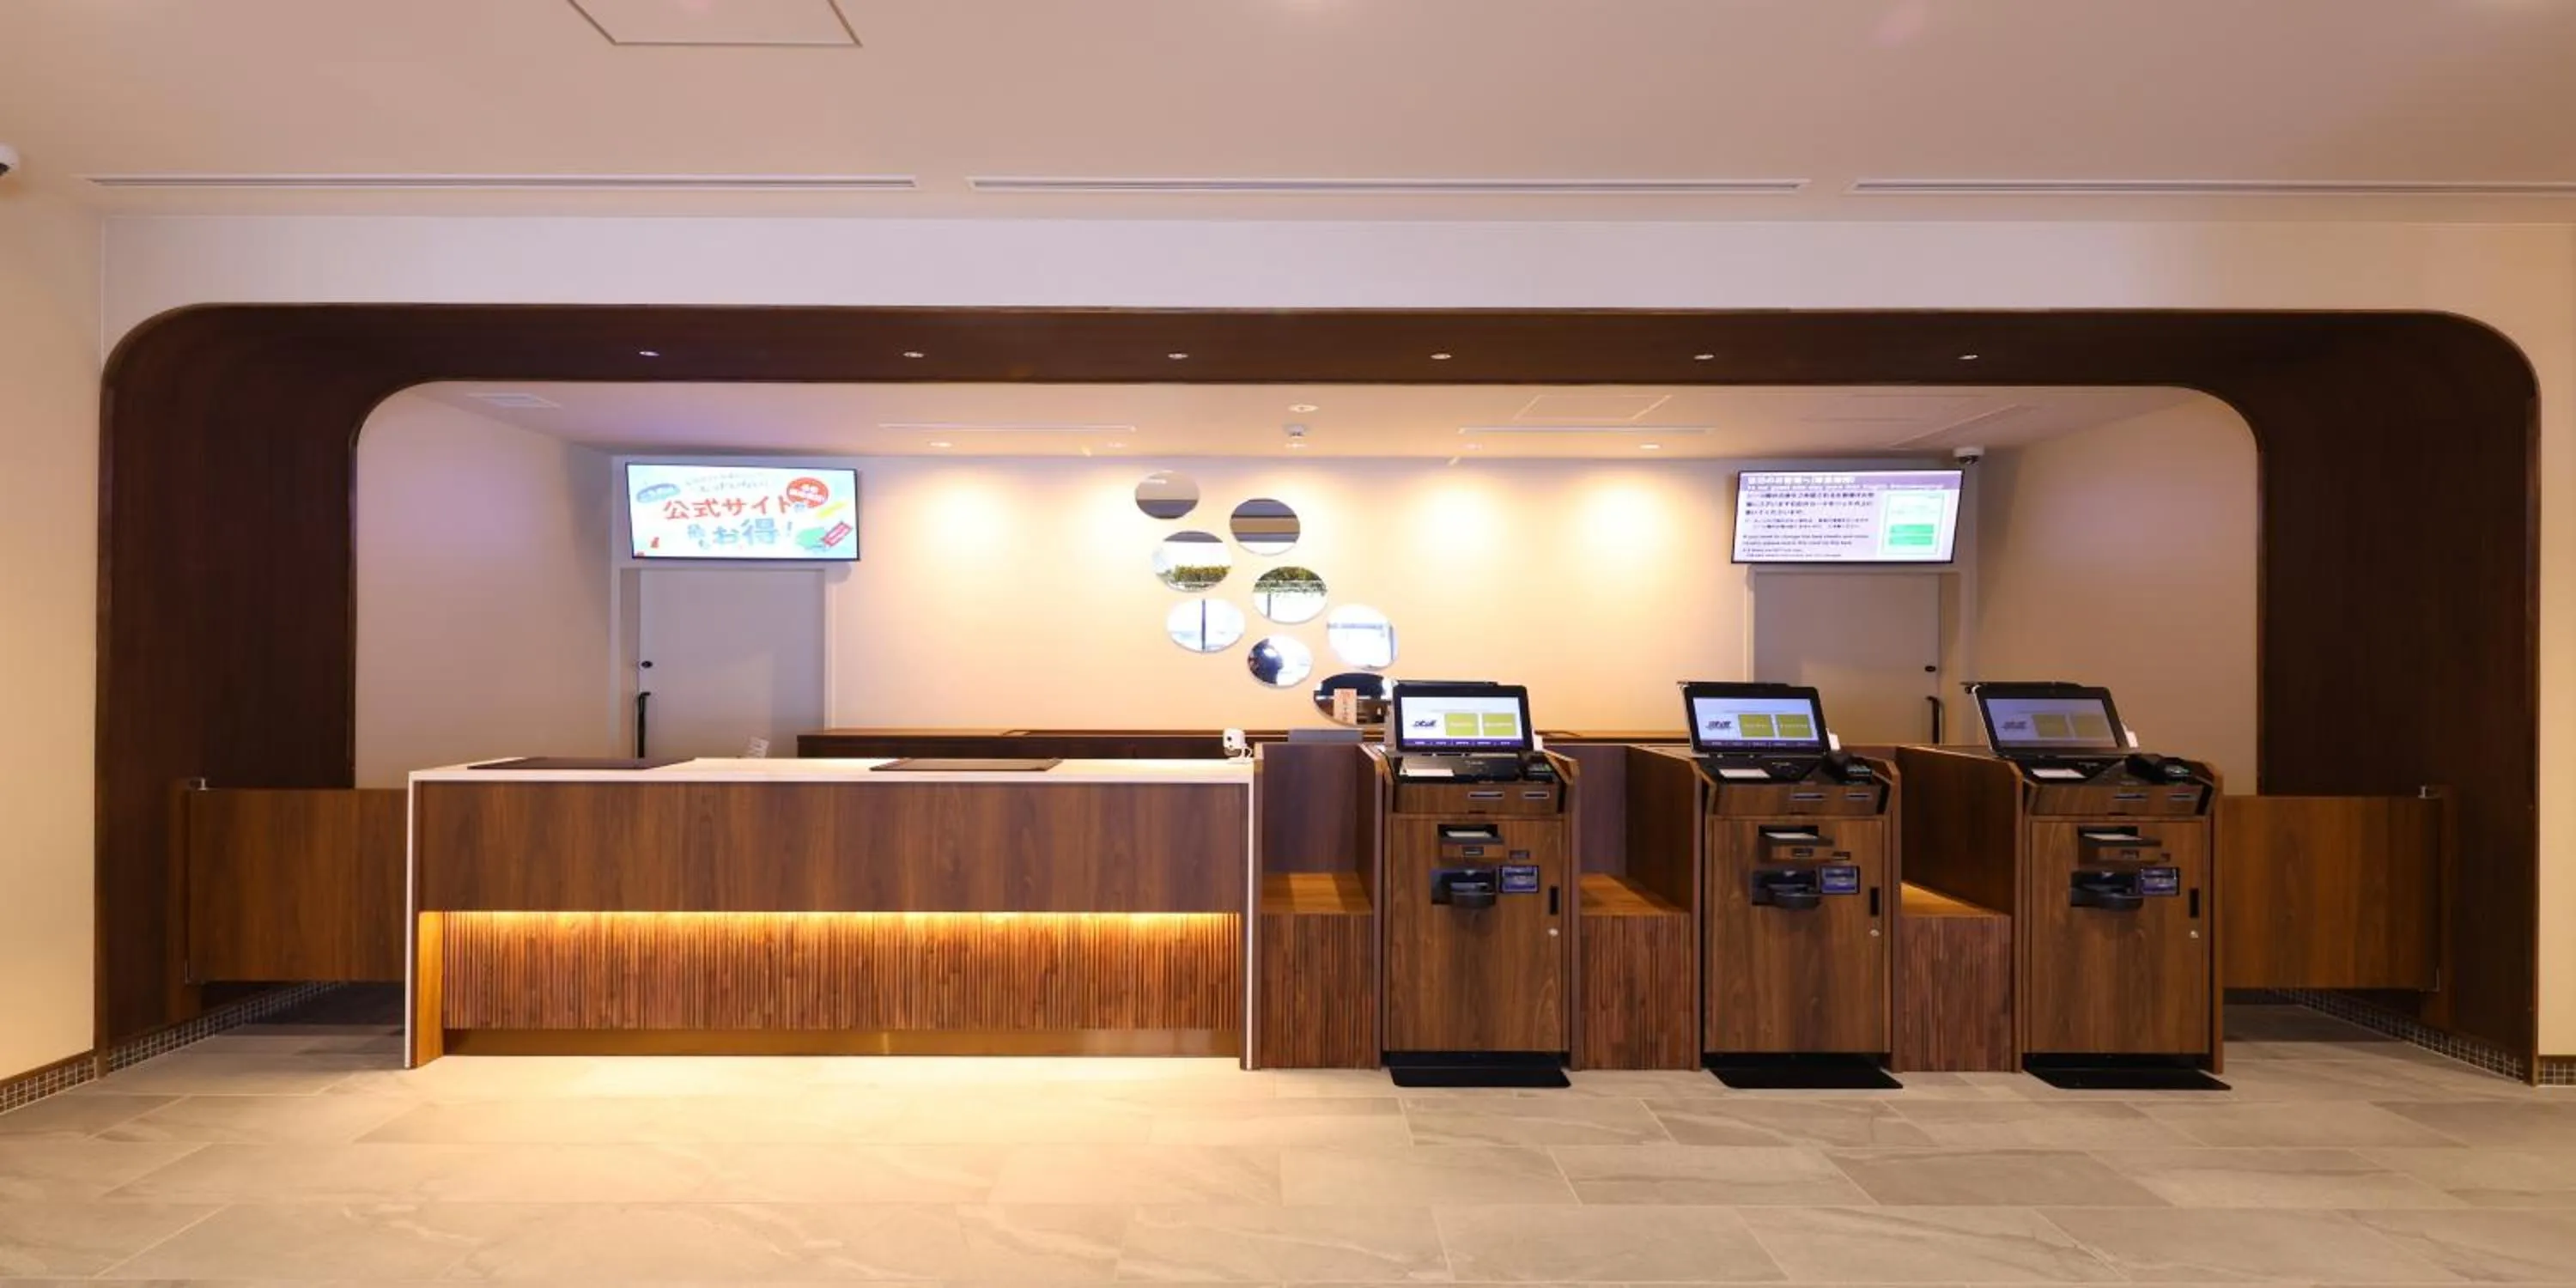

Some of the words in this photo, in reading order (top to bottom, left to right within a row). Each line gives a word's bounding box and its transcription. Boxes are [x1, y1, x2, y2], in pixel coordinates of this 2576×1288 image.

[663, 495, 791, 519] 公式サイト
